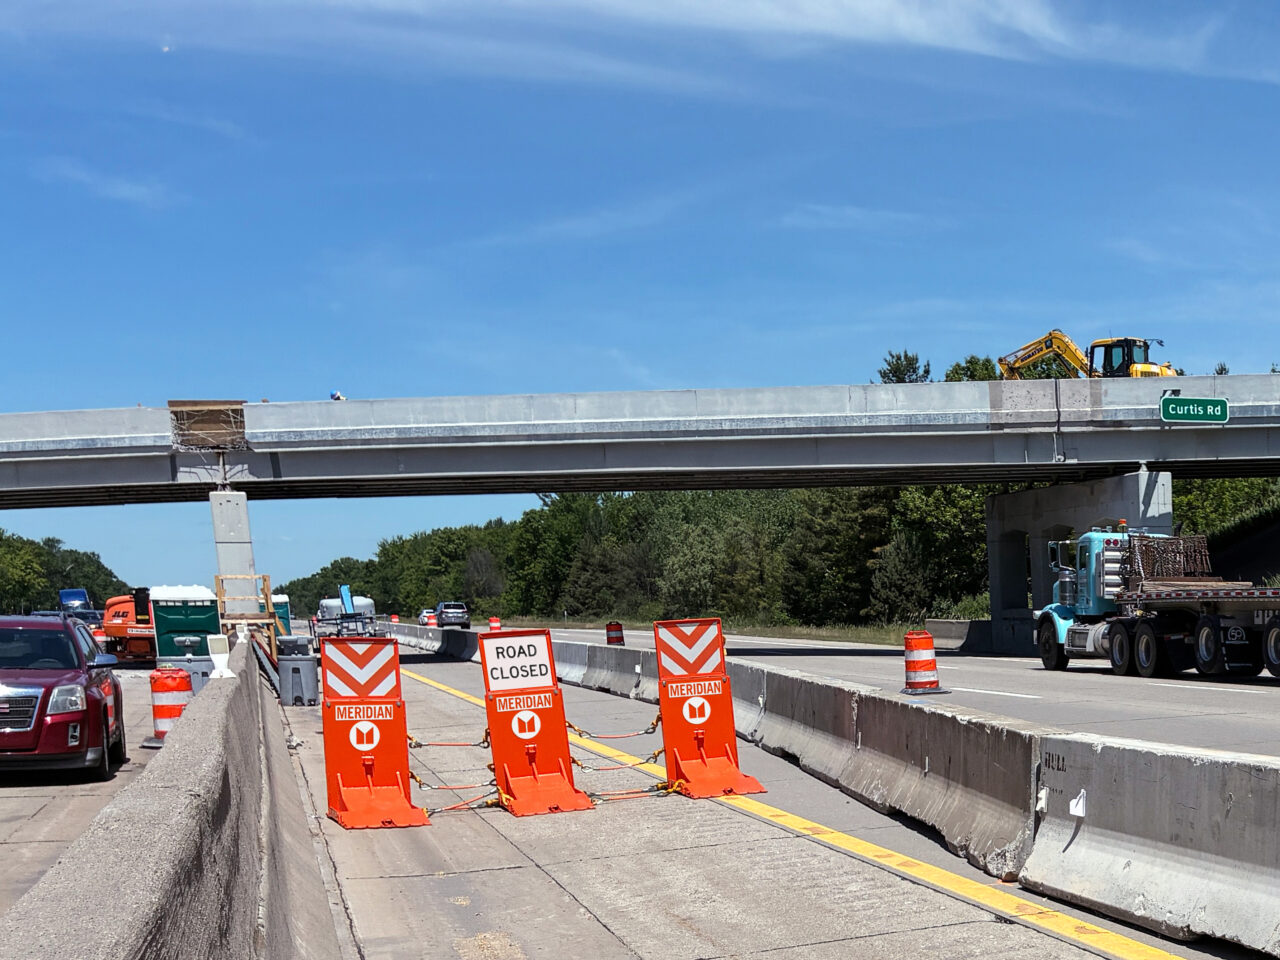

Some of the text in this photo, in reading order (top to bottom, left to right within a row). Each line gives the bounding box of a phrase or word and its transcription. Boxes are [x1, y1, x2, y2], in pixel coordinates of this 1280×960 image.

[1168, 404, 1222, 415] Curtis Rd
[495, 644, 537, 660] ROAD
[490, 663, 549, 681] CLOSED
[669, 681, 721, 697] MERIDIAN
[497, 694, 552, 711] MERIDIAN
[336, 705, 393, 720] MERIDIAN
